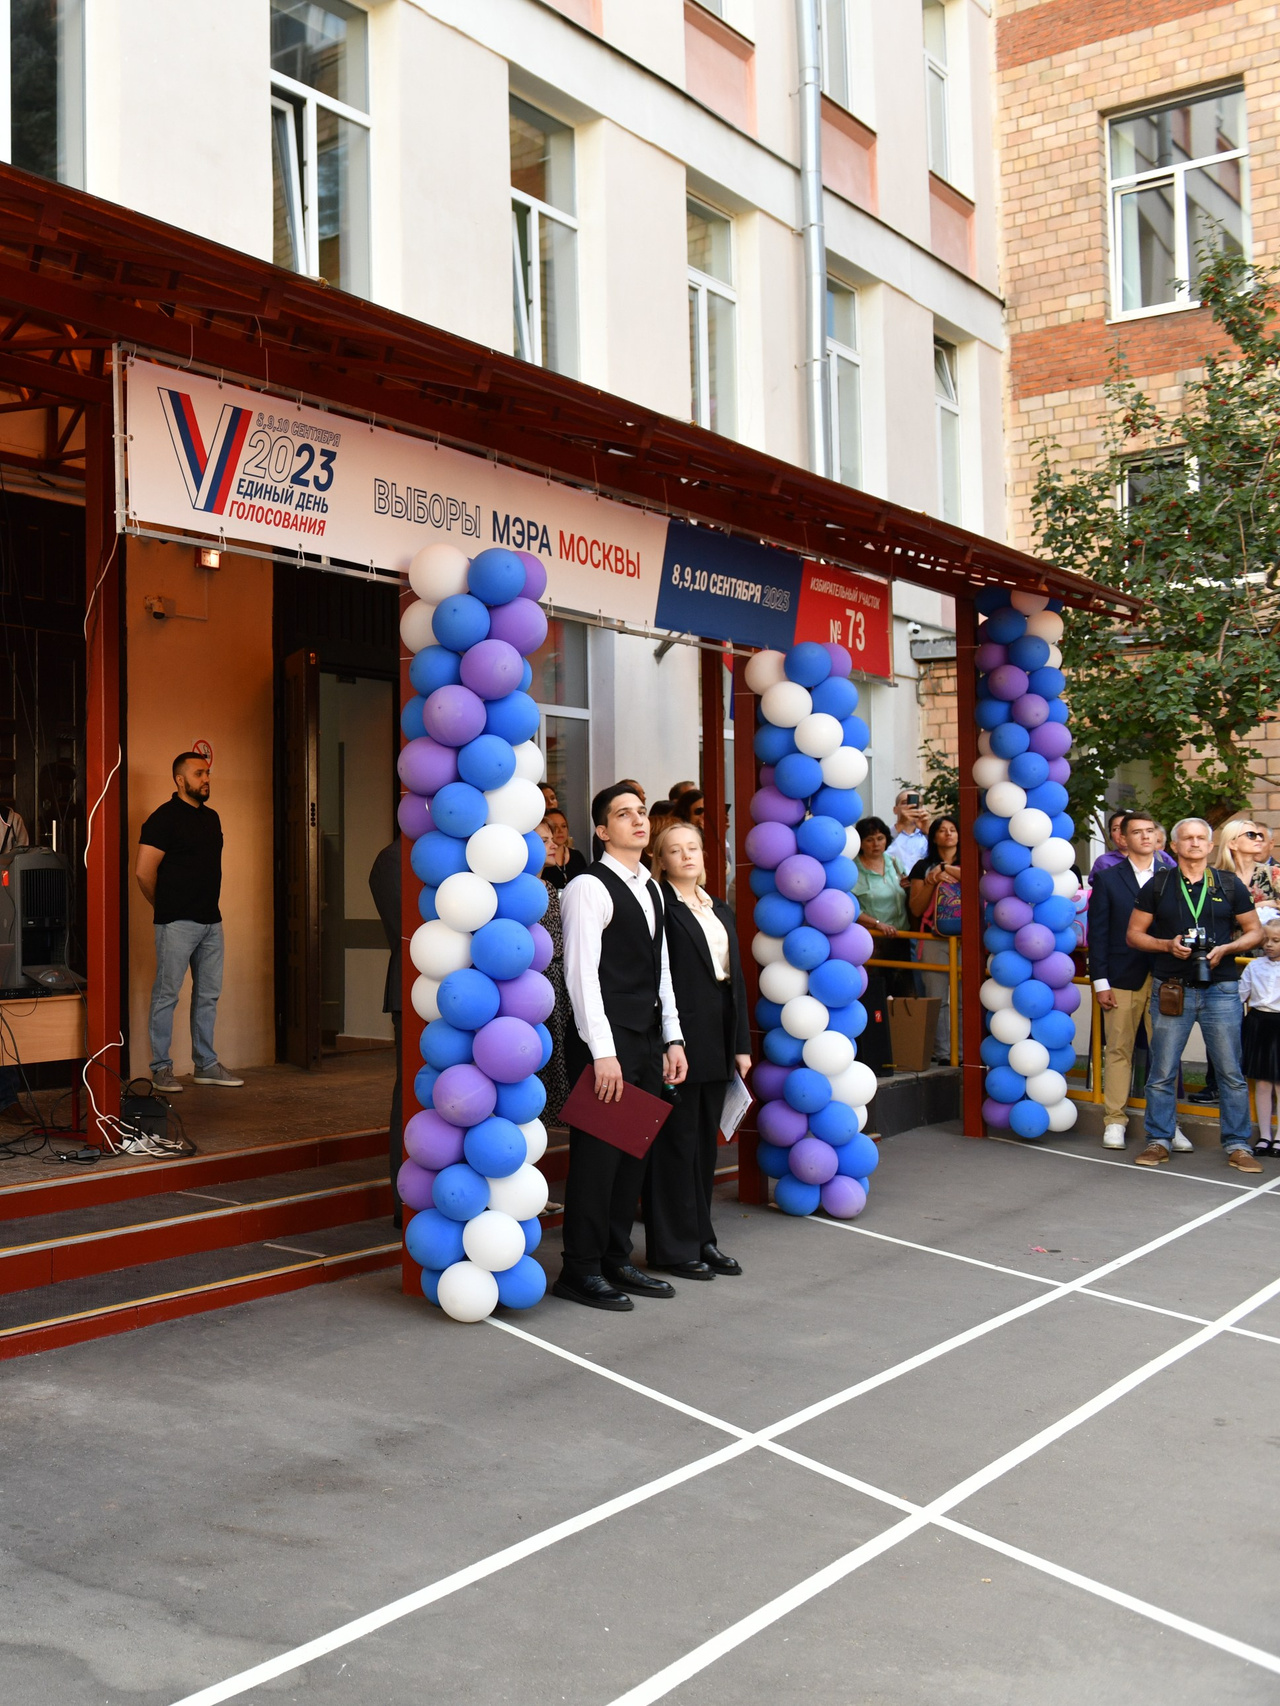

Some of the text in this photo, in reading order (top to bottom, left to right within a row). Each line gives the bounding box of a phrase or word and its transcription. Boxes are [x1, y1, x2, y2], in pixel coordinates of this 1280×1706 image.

[255, 412, 342, 447] 8,9,10 СЕНТЯБРЯ
[242, 429, 338, 492] 2023
[236, 478, 329, 514] ЕДИНЫЙ ДЕНЬ
[228, 500, 327, 537] ГОЛОСОВАНИЯ
[373, 477, 641, 579] ВЫБОРЫ МЭРА МОСКВЫ
[671, 563, 791, 612] 8,9,10 СЕНТЯБРЯ 2023
[810, 576, 881, 610] ИЗБИРАТЕЛЬНЫЙ УЧАСТОК
[845, 608, 866, 652] 73
